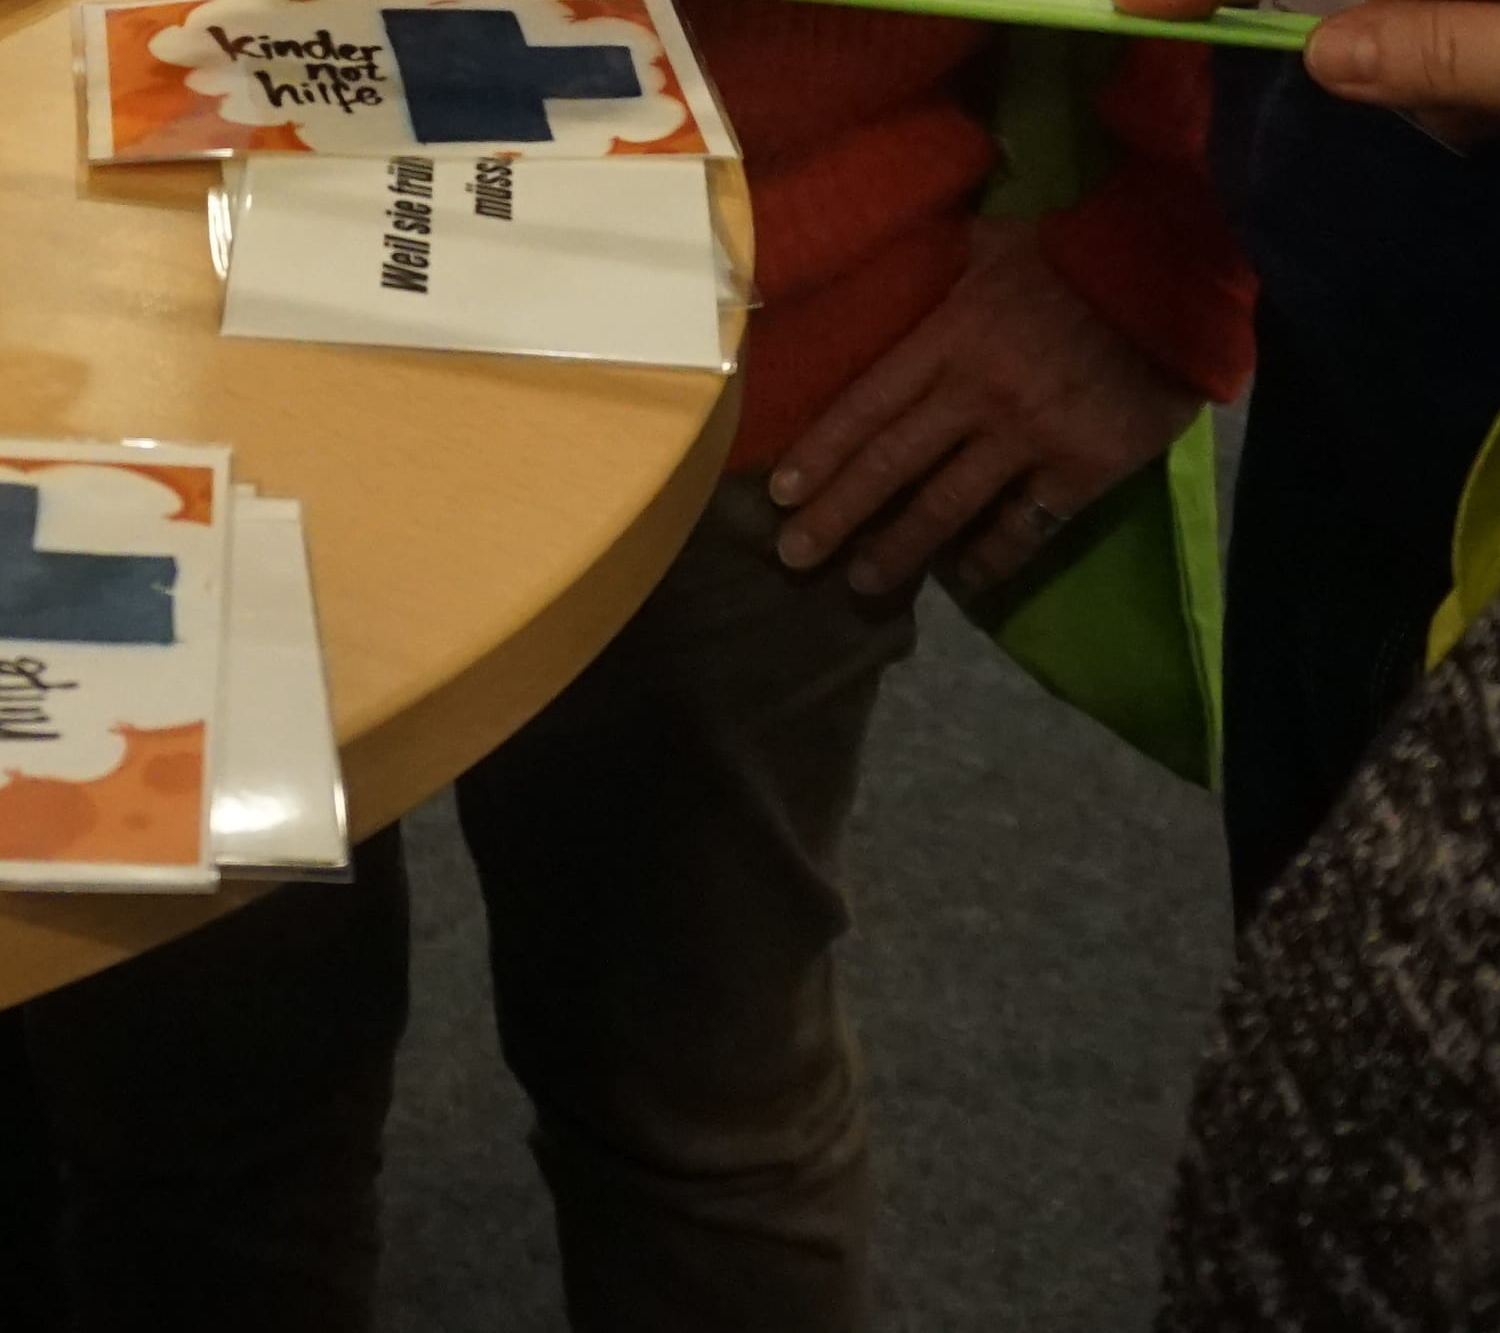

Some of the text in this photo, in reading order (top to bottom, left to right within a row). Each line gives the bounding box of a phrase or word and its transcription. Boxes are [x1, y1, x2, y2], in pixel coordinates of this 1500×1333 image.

[207, 25, 384, 67] kinder
[255, 70, 383, 114] hilfe
[306, 58, 385, 84] not
[464, 156, 514, 221] müss
[385, 200, 433, 235] sie
[381, 234, 431, 295] Weil
